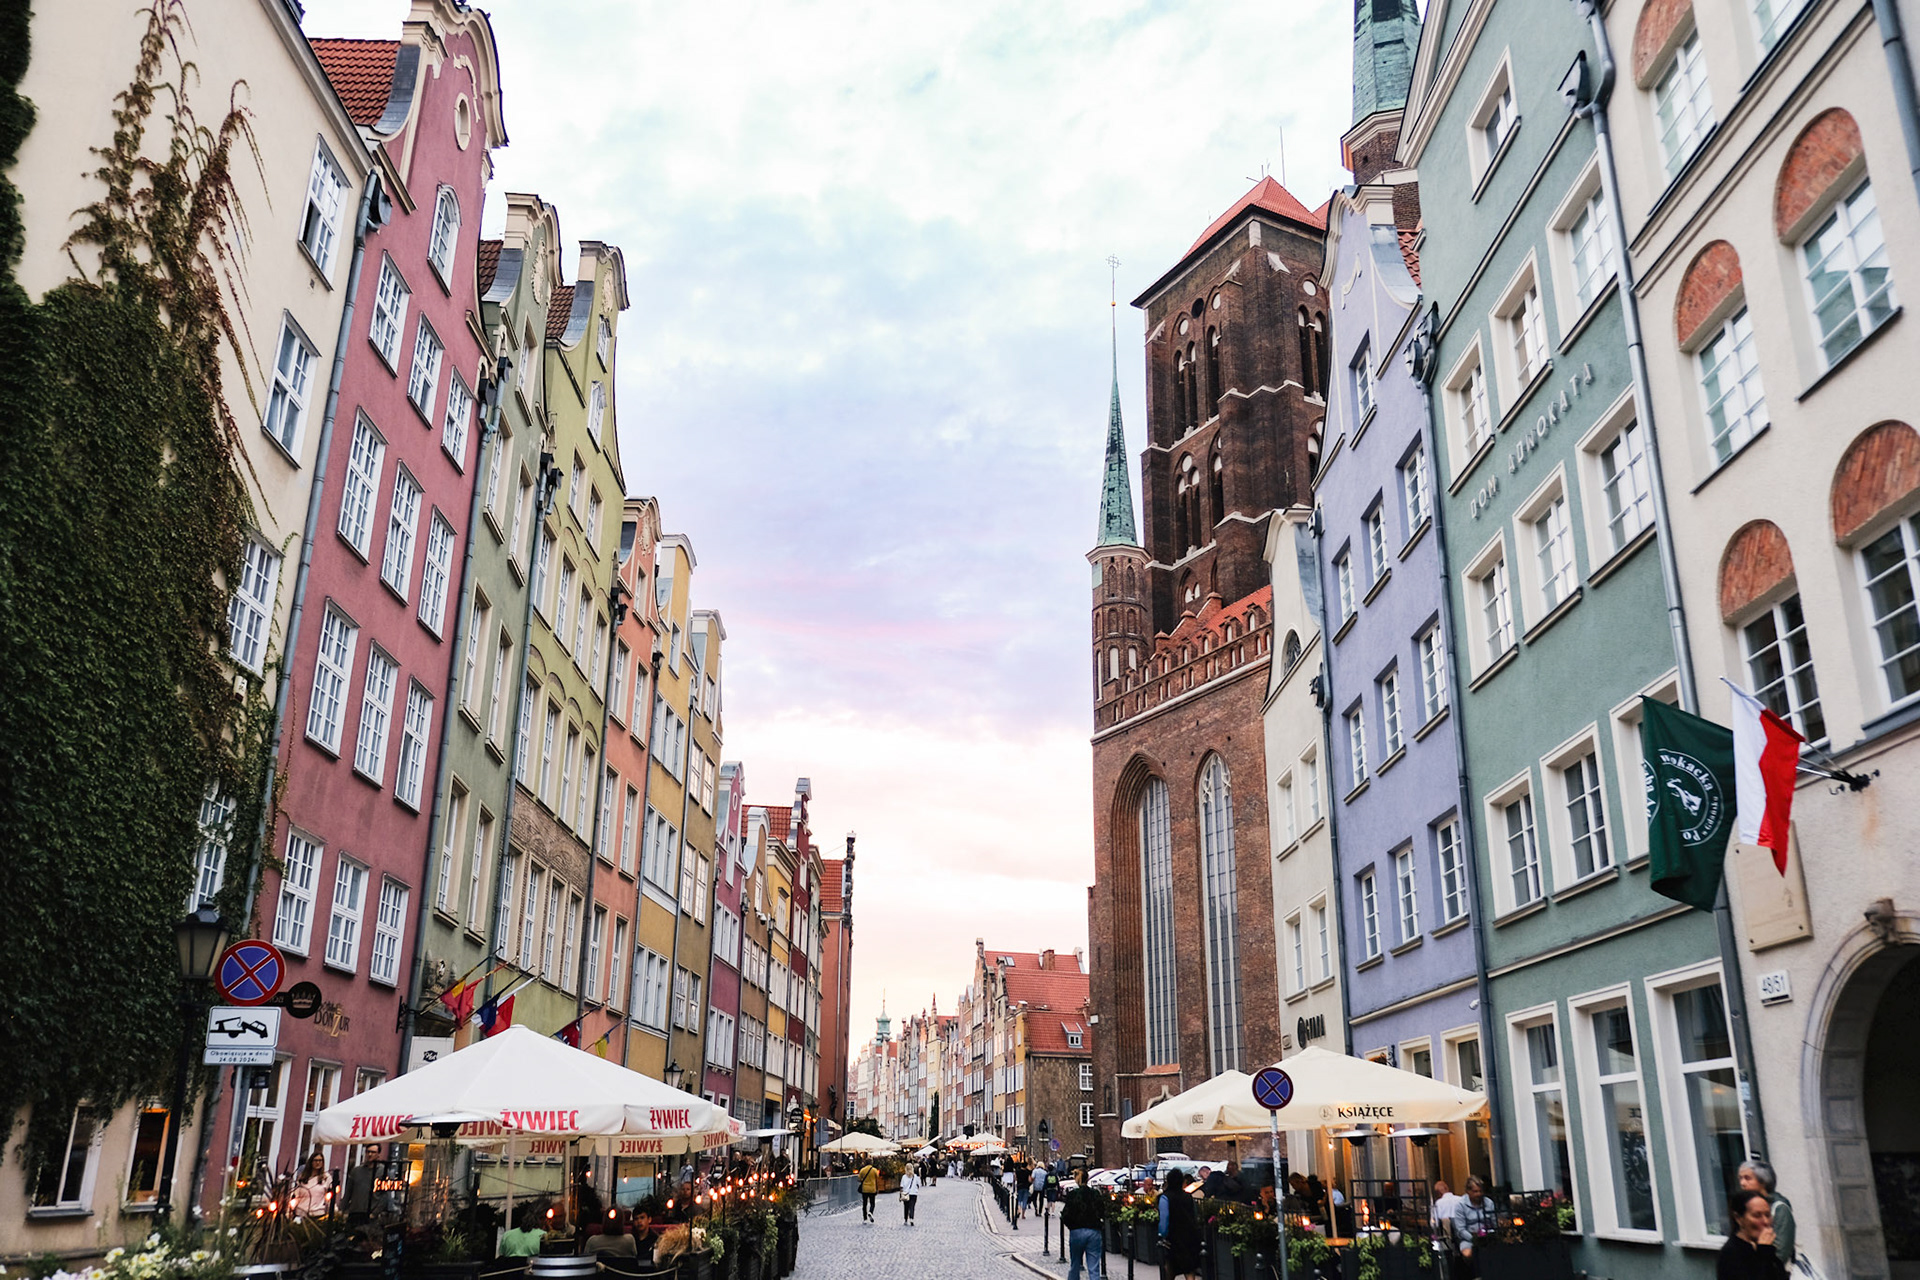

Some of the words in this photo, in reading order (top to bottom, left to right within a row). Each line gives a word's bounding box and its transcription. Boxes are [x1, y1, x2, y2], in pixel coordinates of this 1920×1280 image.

[1470, 474, 1498, 520] DOM
[1508, 362, 1595, 474] ADWOKATA
[500, 1108, 579, 1131] ŻYWIEC
[649, 1107, 691, 1130] ŻYWIEC
[1337, 1104, 1394, 1119] KSIĄŻĘCE
